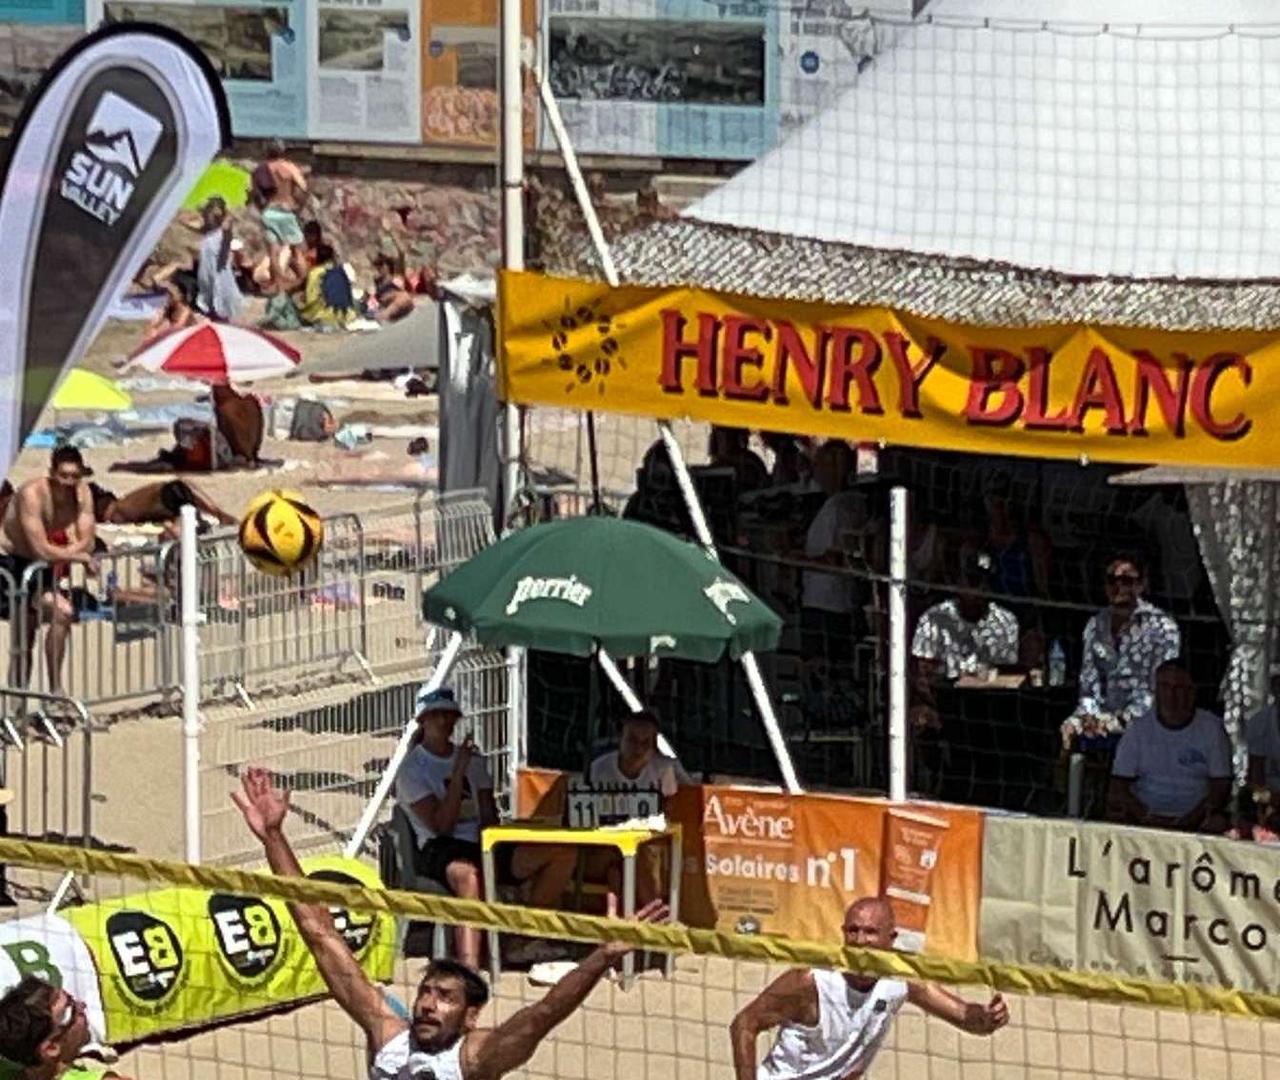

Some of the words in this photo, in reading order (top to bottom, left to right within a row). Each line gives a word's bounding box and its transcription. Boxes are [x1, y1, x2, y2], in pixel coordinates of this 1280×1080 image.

[65, 151, 135, 210] SUN
[659, 308, 946, 419] HENRY
[961, 341, 1254, 440] BLANC
[506, 574, 593, 617] perrier
[703, 794, 795, 840] Avène
[706, 853, 800, 884] Solaires
[1092, 889, 1268, 952] Marco
